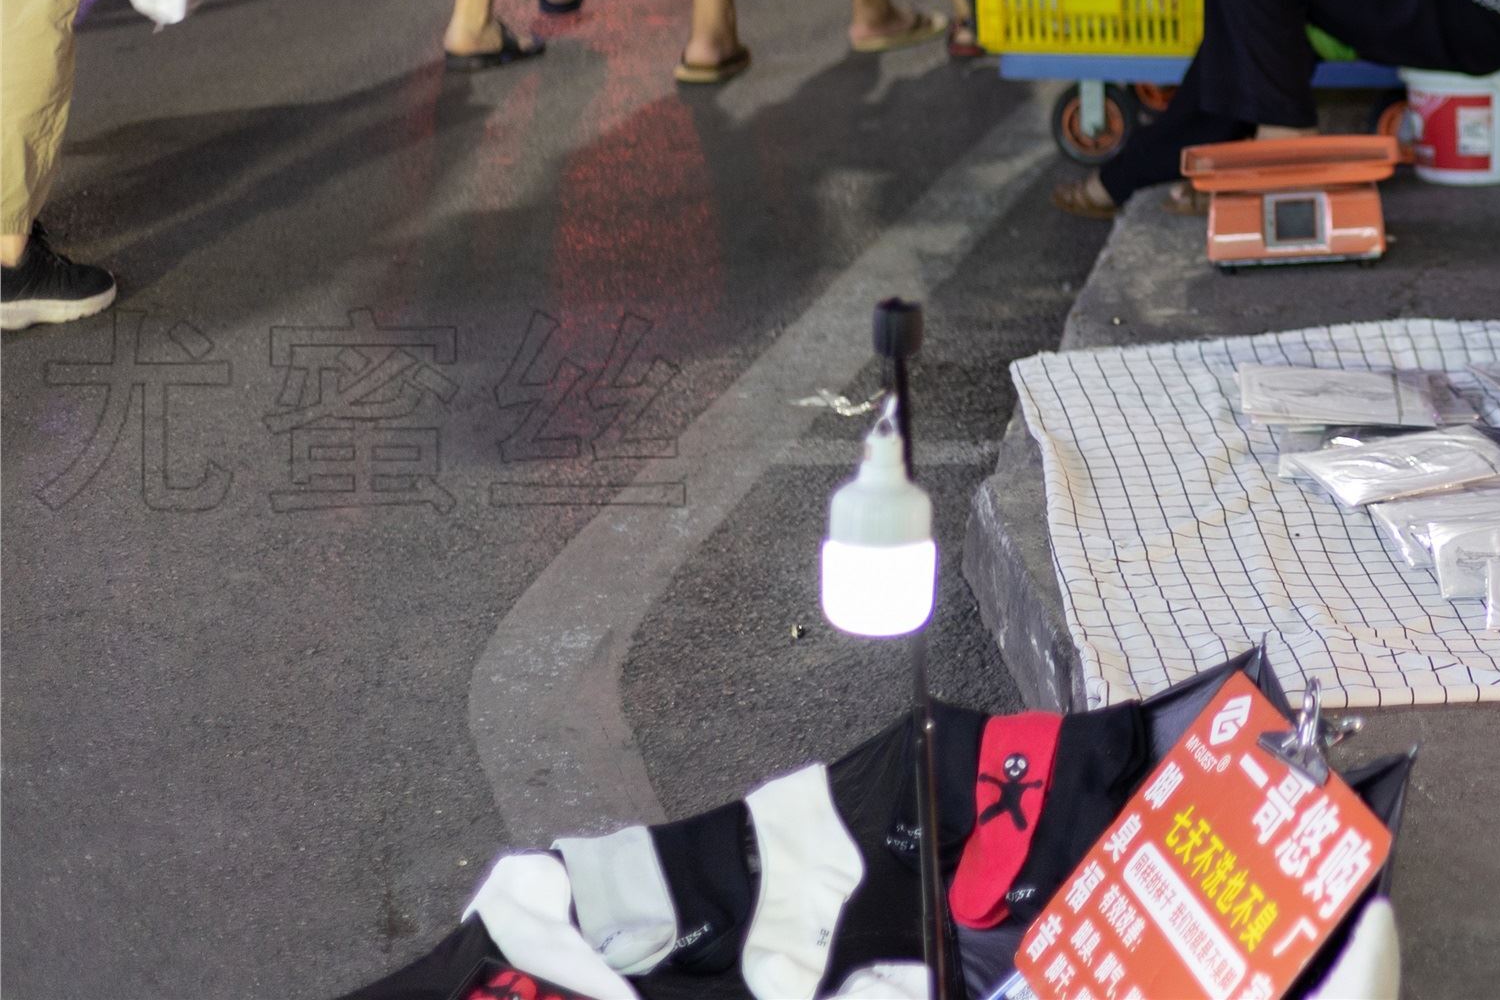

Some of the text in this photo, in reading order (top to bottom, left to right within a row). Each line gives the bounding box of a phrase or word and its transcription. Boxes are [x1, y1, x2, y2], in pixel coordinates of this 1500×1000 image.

[1184, 734, 1219, 774] MY GUEST
[1026, 760, 1184, 964] 脚臭福音
[1133, 851, 1177, 911] 同样的袜子
[1164, 805, 1280, 953] 七天不洗也不臭
[1239, 753, 1373, 920] 一哥悠购
